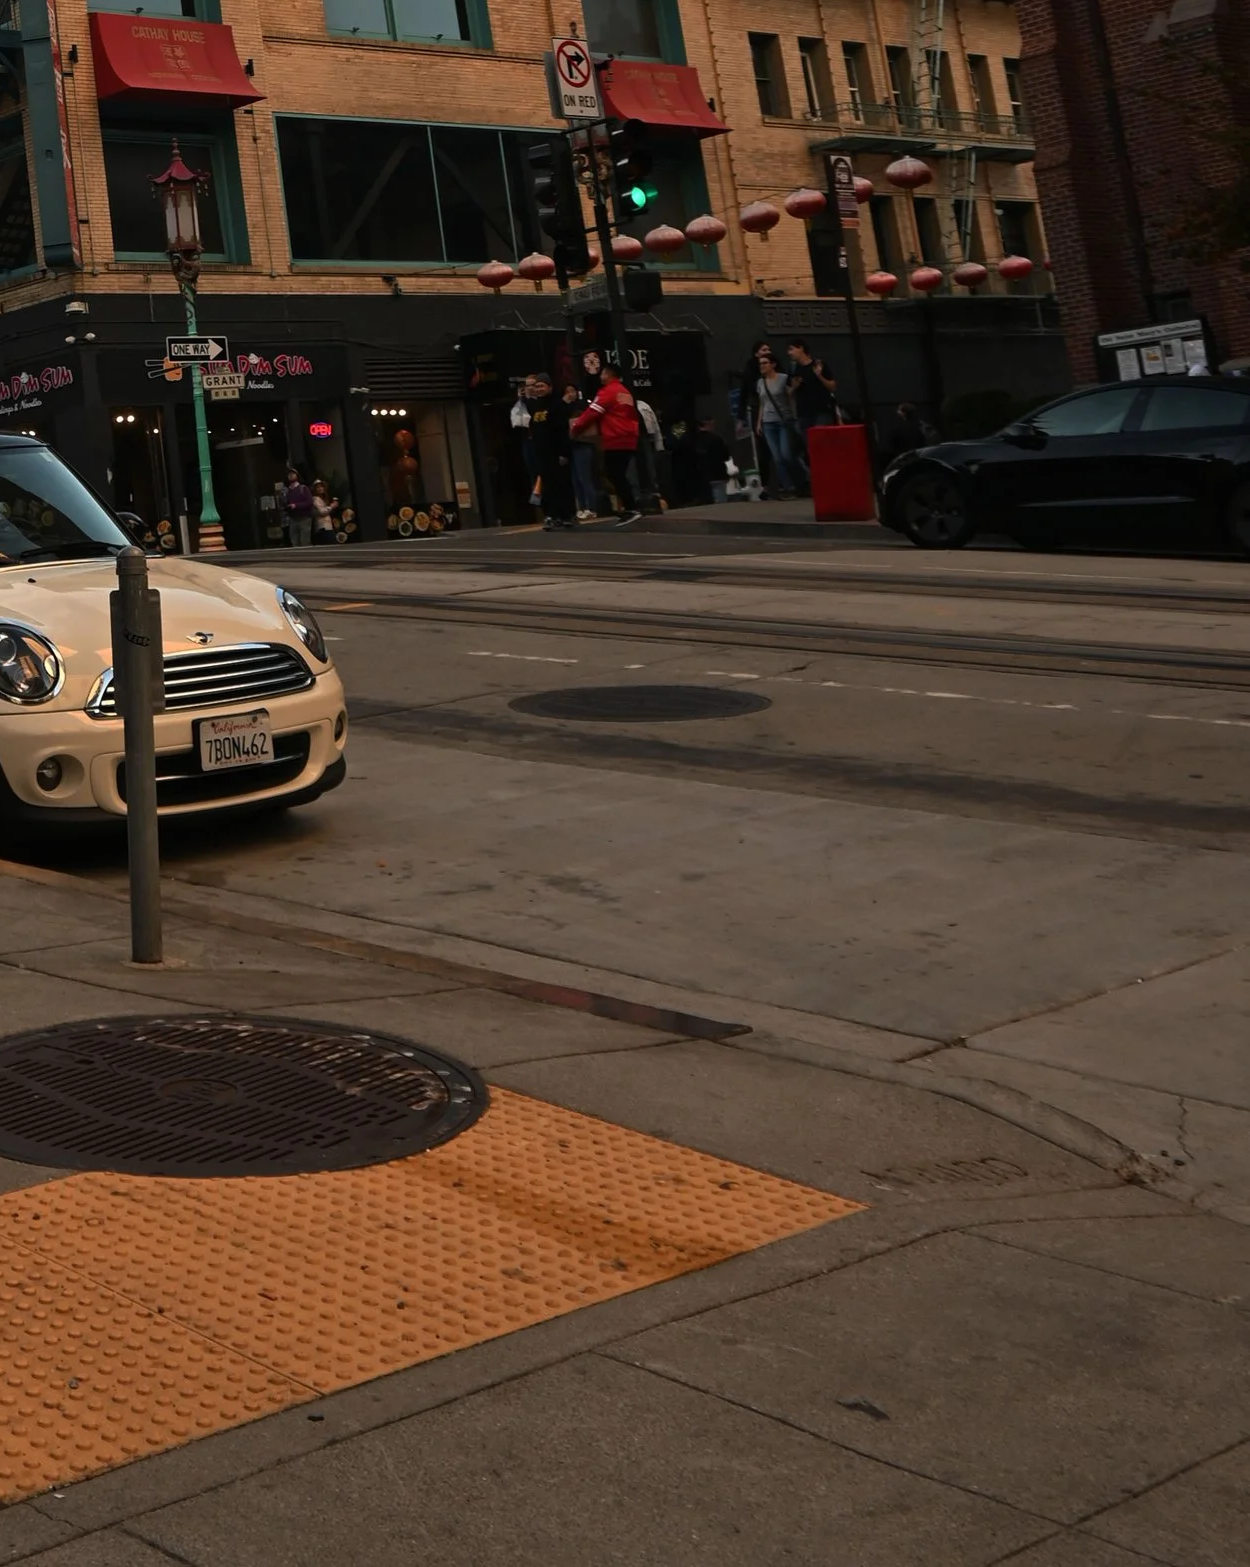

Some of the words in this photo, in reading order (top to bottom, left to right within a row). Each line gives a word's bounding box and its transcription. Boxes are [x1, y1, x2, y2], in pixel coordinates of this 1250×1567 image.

[131, 25, 169, 41] CATHAY
[171, 29, 206, 45] HOUSE
[564, 94, 576, 107] ON
[578, 95, 596, 108] RED
[172, 344, 191, 355] ONE
[193, 343, 210, 354] WAY
[273, 354, 314, 378] SUM
[40, 366, 74, 392] SUM
[205, 375, 241, 386] GRANT
[310, 424, 332, 436] OPEN
[213, 721, 257, 735] California
